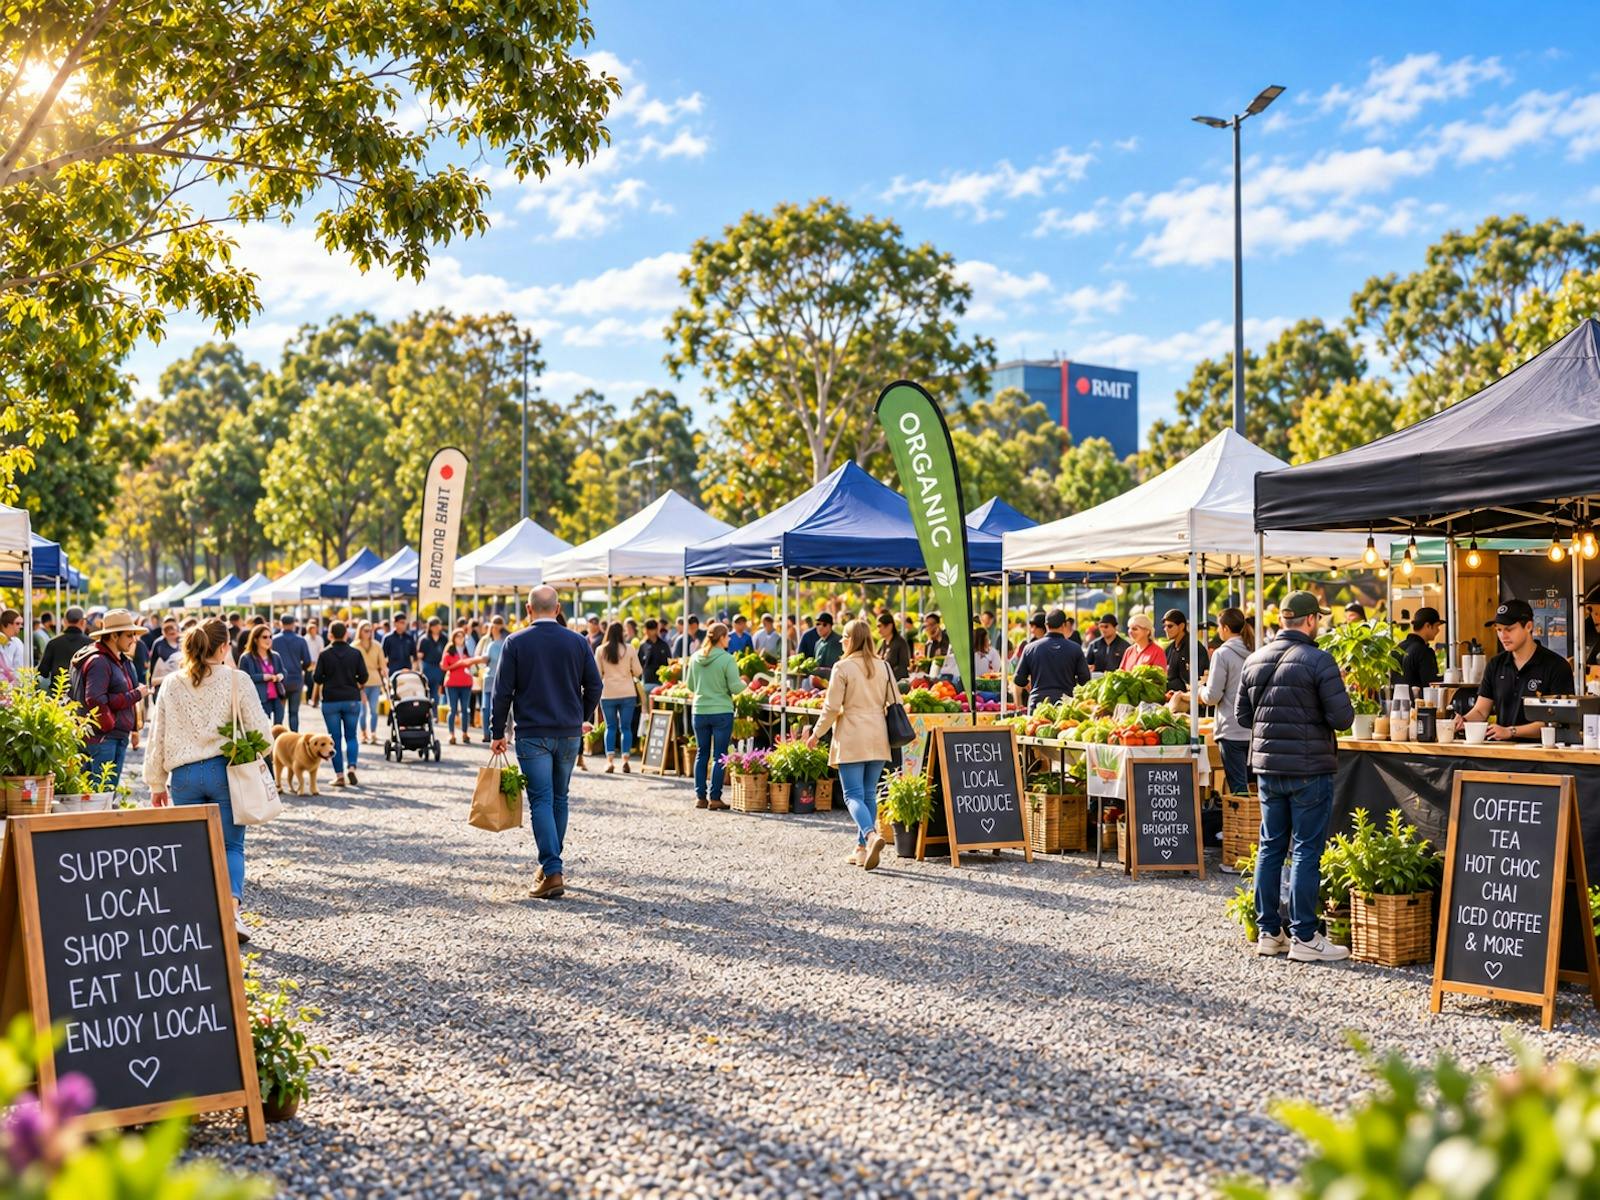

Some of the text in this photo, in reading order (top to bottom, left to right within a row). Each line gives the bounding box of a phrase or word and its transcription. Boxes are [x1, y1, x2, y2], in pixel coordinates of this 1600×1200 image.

[1092, 379, 1131, 399] RMIT
[900, 412, 952, 547] ORGANIC
[954, 743, 1002, 762] FRESH
[962, 770, 1004, 789] LOCAL
[1148, 771, 1178, 782] FARM
[1148, 785, 1180, 795] FRESH
[957, 793, 1013, 813] PRODUCE
[1151, 798, 1177, 809] GOOD
[1473, 797, 1543, 824] COFFEE
[1152, 811, 1178, 822] FOOD
[1142, 824, 1189, 835] BRIGHTER
[1489, 829, 1521, 850] TEA
[1153, 837, 1179, 847] DAYS
[59, 844, 182, 882] SUPPORT
[1464, 854, 1541, 879] HOT CHOC
[1482, 882, 1517, 903] CHAI
[86, 887, 170, 921] LOCAL
[1457, 905, 1542, 934] ICED COFFEE
[64, 923, 212, 966] SHOP LOCAL
[1465, 932, 1524, 957] & MORE
[70, 964, 211, 1009] EAT LOCAL
[66, 1004, 227, 1053] ENJOY LOCAL
